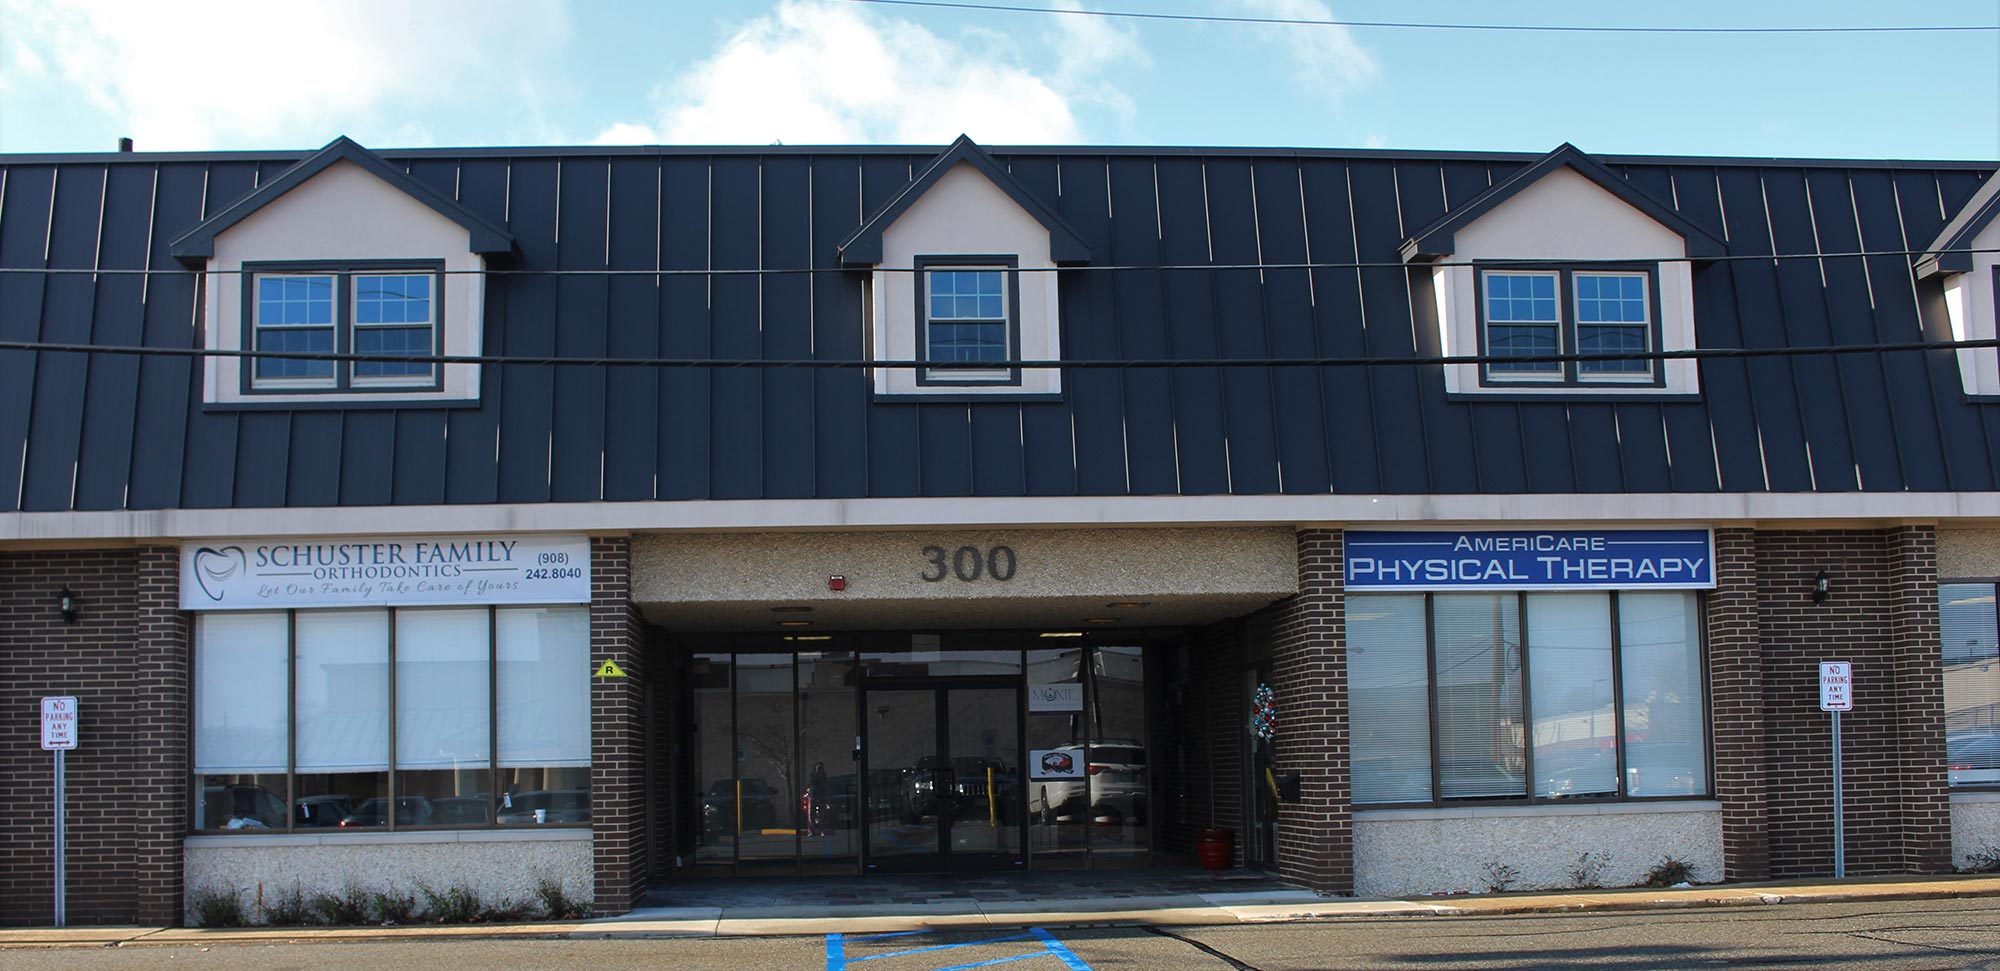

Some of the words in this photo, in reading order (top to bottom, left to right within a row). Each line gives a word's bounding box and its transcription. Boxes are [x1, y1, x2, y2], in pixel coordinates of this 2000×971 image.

[256, 543, 407, 567] SCHUSTER
[415, 540, 518, 563] FAMILY
[537, 552, 569, 565] (908)
[921, 545, 1016, 582] 300
[1349, 557, 1529, 581] PHYSICAL
[1537, 556, 1704, 580] THERAPY
[313, 564, 461, 580] ORTHODONTICS
[525, 567, 582, 580] 242.8040
[257, 584, 280, 598] Let
[286, 583, 314, 595] Our
[321, 582, 372, 598] Family
[379, 581, 410, 594] Take
[416, 580, 450, 592] Care
[457, 578, 474, 595] of
[477, 578, 519, 596] Yours
[605, 666, 613, 674] R
[1829, 665, 1841, 675] NO
[1823, 676, 1848, 684] PARKING
[53, 702, 66, 711] NO
[45, 713, 74, 721] PARKING
